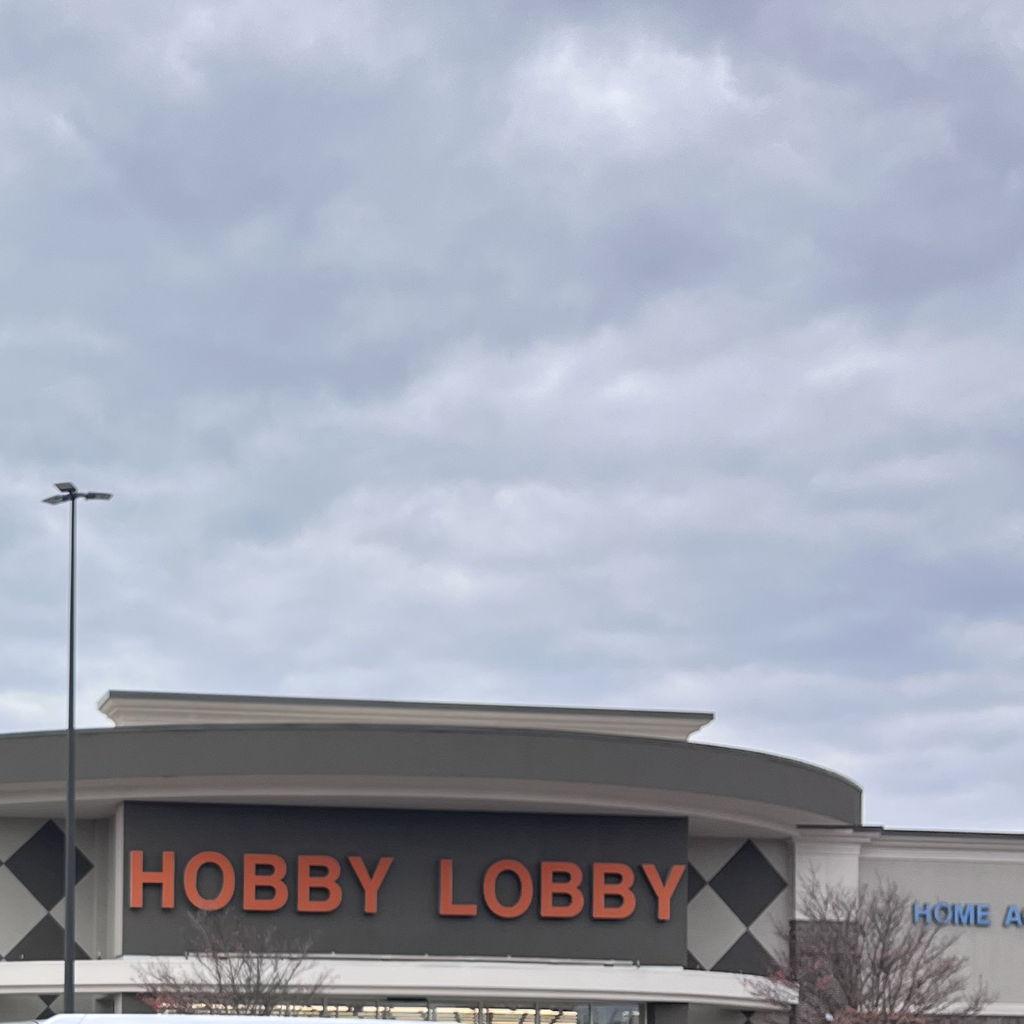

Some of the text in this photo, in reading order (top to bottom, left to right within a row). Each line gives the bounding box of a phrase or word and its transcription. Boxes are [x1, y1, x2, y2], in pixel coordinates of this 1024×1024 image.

[129, 850, 686, 921] HOBBY LOBBY
[912, 900, 1024, 929] HOME A
